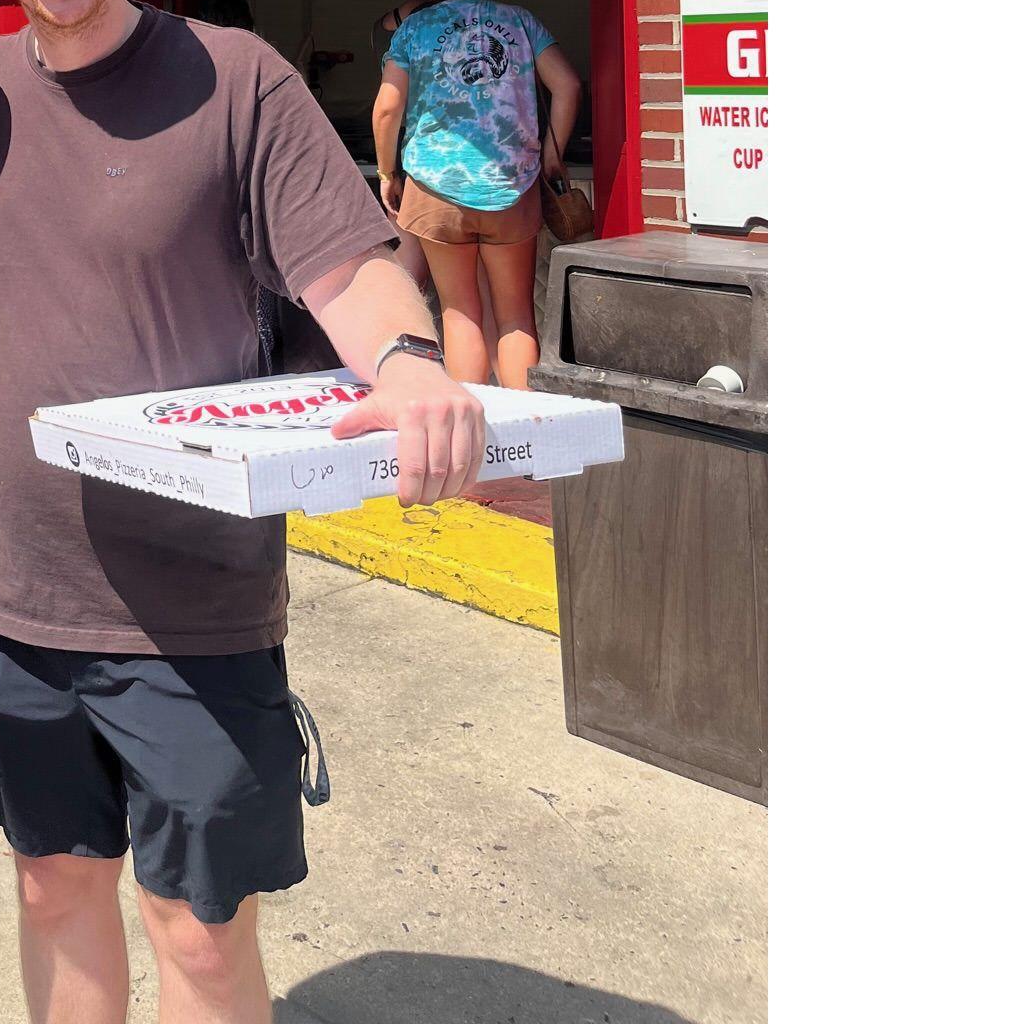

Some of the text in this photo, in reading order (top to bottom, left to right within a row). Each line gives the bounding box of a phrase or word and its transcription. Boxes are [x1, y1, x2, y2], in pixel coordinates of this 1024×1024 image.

[433, 17, 519, 53] LOCALS ONLY
[727, 29, 768, 78] G
[433, 71, 470, 100] LONG
[699, 107, 751, 127] WATER
[106, 167, 127, 177] OBEY
[733, 148, 763, 169] CUP
[368, 441, 533, 480] 736 Street
